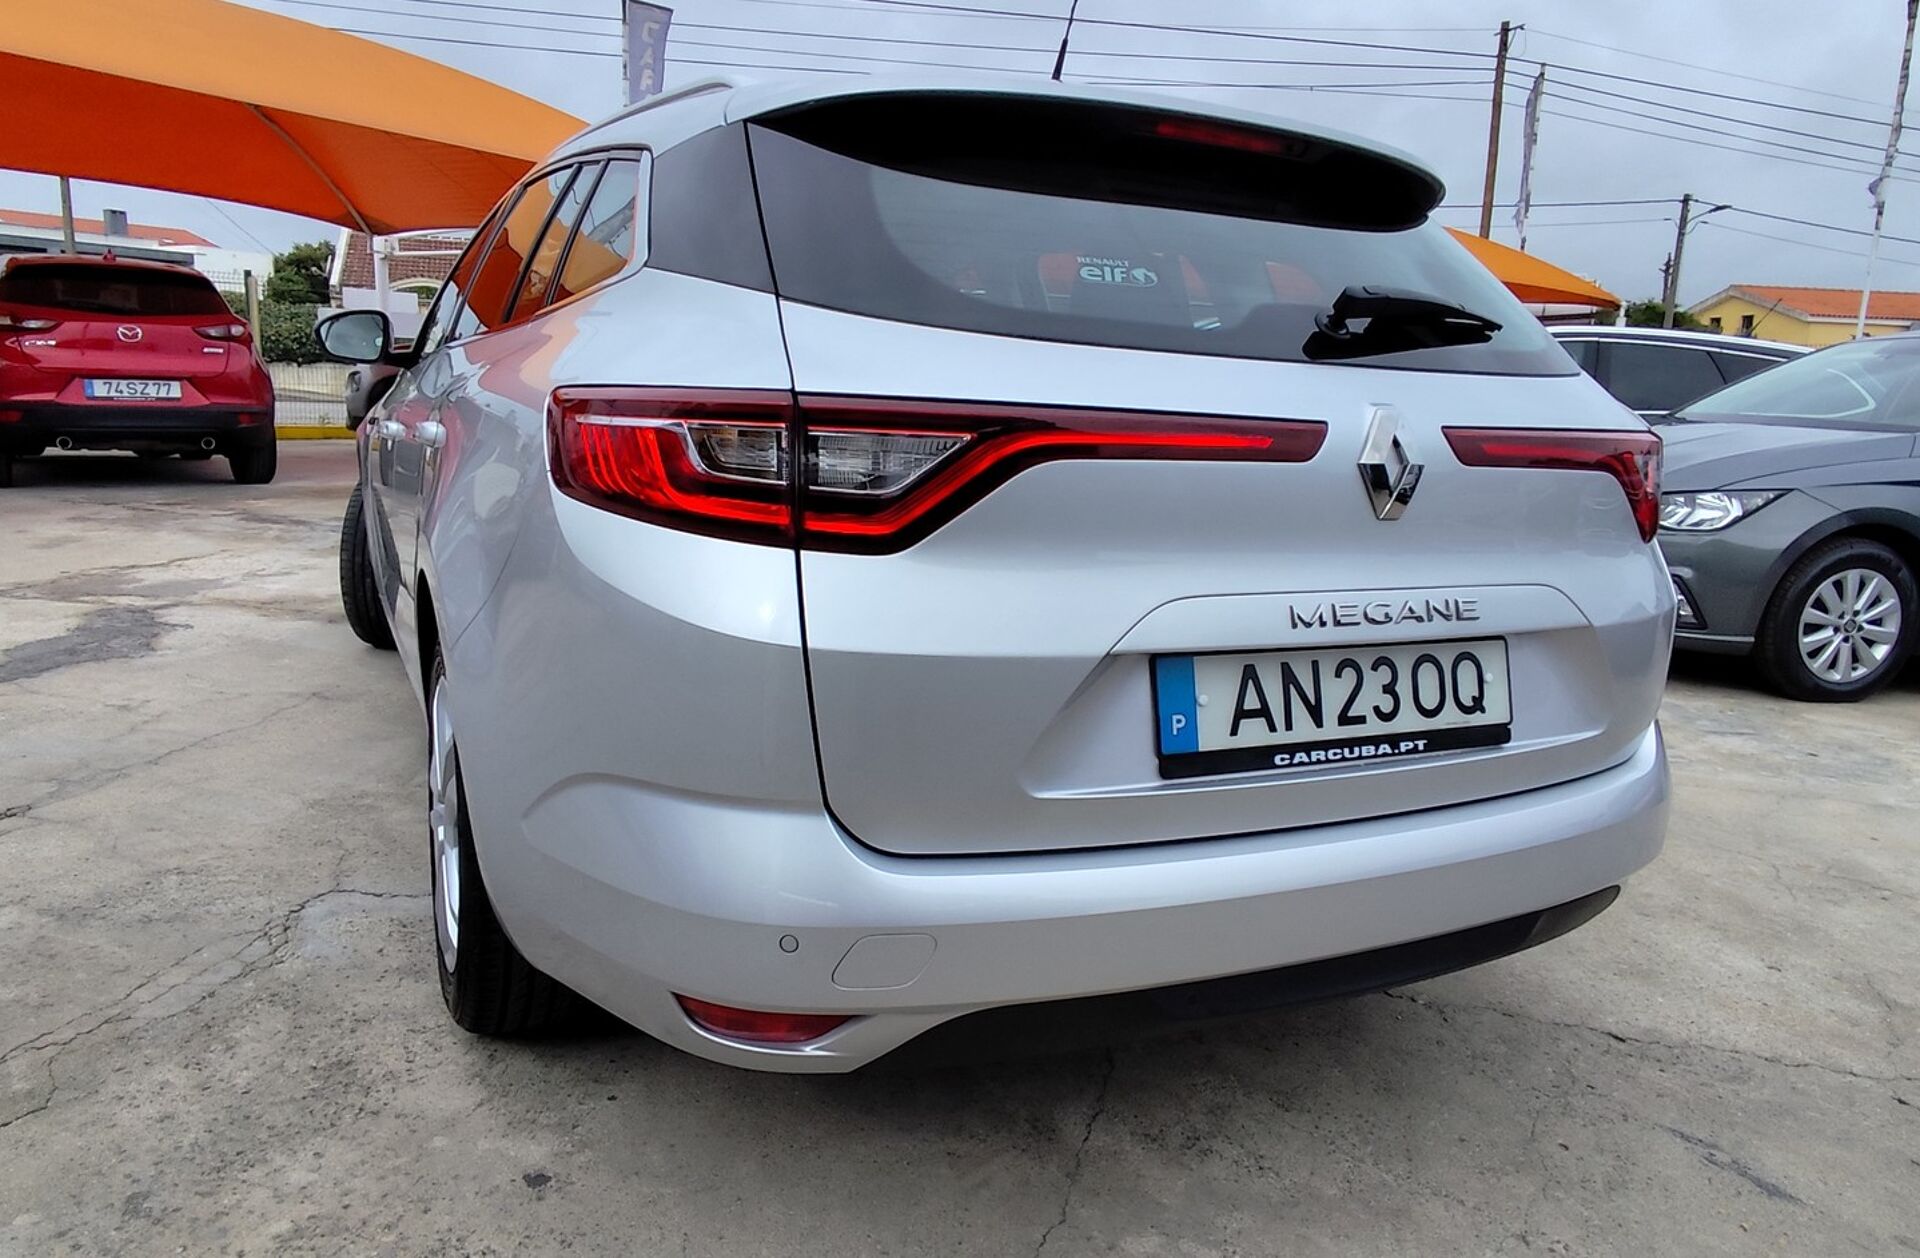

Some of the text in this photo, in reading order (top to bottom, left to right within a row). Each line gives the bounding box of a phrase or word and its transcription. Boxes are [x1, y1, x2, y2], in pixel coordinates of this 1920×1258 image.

[1076, 256, 1129, 268] RENAULT
[1079, 266, 1128, 283] elf
[102, 381, 172, 396] 74SZ77
[1290, 597, 1480, 630] MEGANE
[1171, 714, 1187, 736] P
[1273, 739, 1429, 766] CARCUBA.PT
